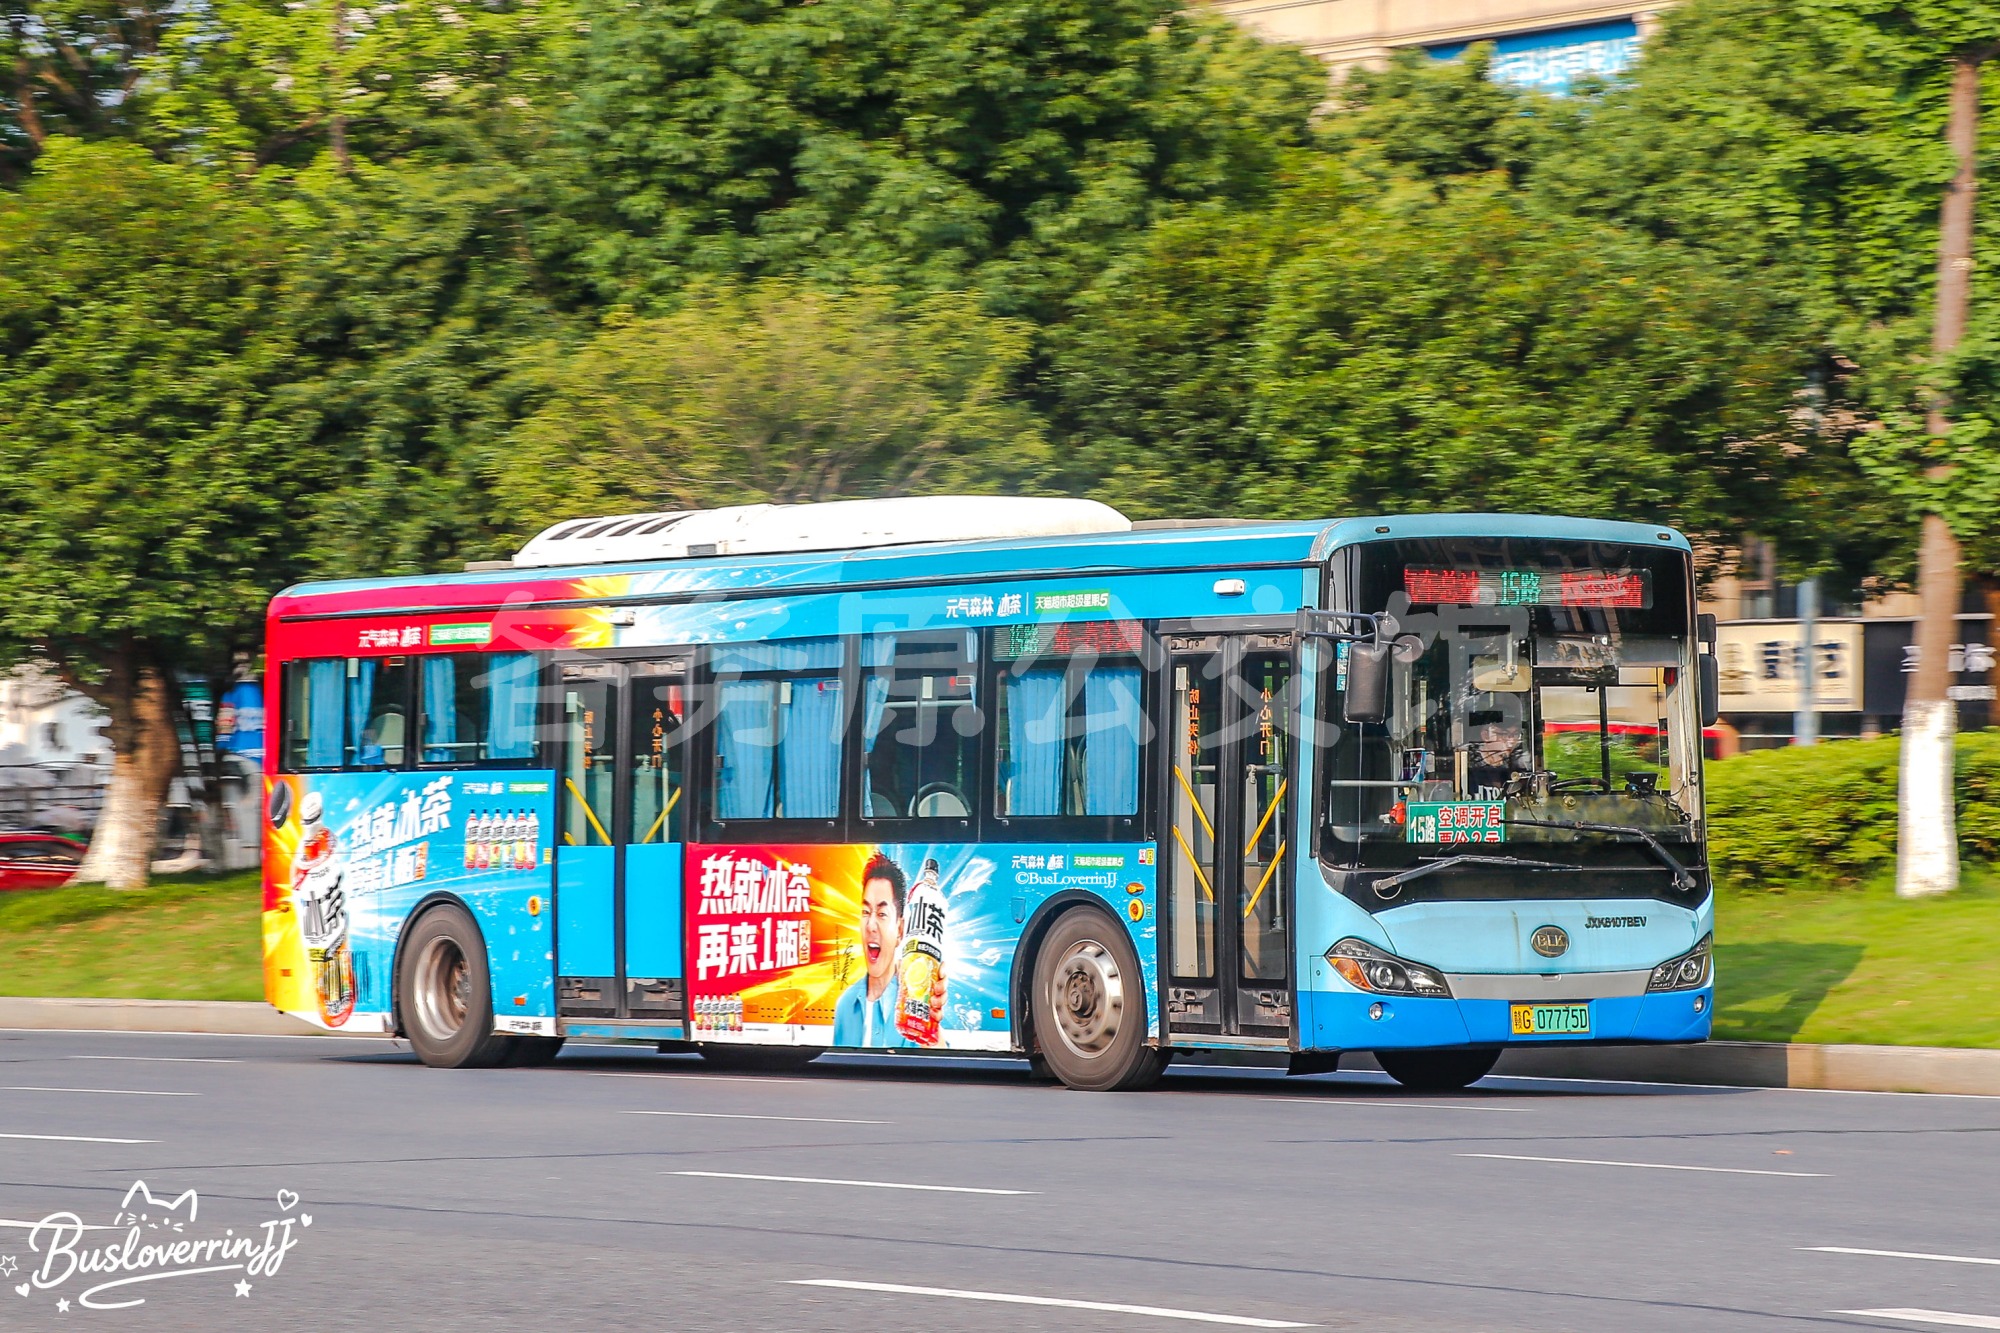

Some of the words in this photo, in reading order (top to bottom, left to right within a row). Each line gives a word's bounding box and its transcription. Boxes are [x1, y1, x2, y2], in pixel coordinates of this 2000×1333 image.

[946, 596, 994, 618] 元气森林
[1438, 806, 1501, 828] 空调开启
[698, 850, 811, 915] 热就冰茶
[696, 917, 799, 981] 再来1瓶
[1536, 934, 1566, 947] BLK
